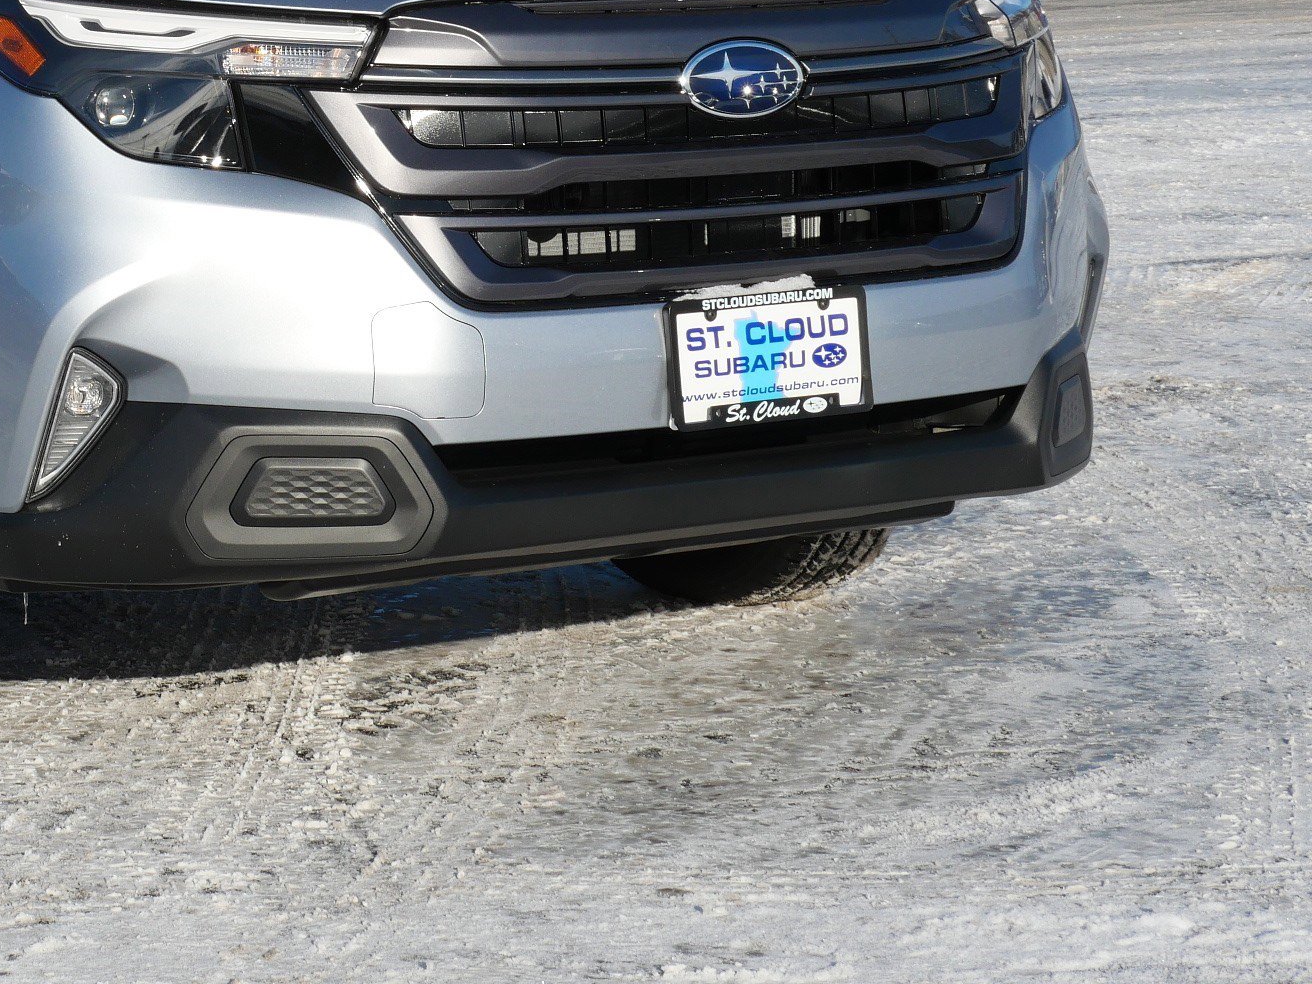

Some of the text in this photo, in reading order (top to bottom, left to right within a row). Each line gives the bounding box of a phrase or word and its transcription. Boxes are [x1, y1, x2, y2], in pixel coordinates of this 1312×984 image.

[701, 287, 834, 311] STCLOUDSUBARU.COM
[686, 313, 849, 352] ST. CLOUD
[694, 350, 807, 379] SUBARU
[682, 375, 860, 403] www.stcloudsubaru.com
[725, 399, 801, 423] St. Cloud
